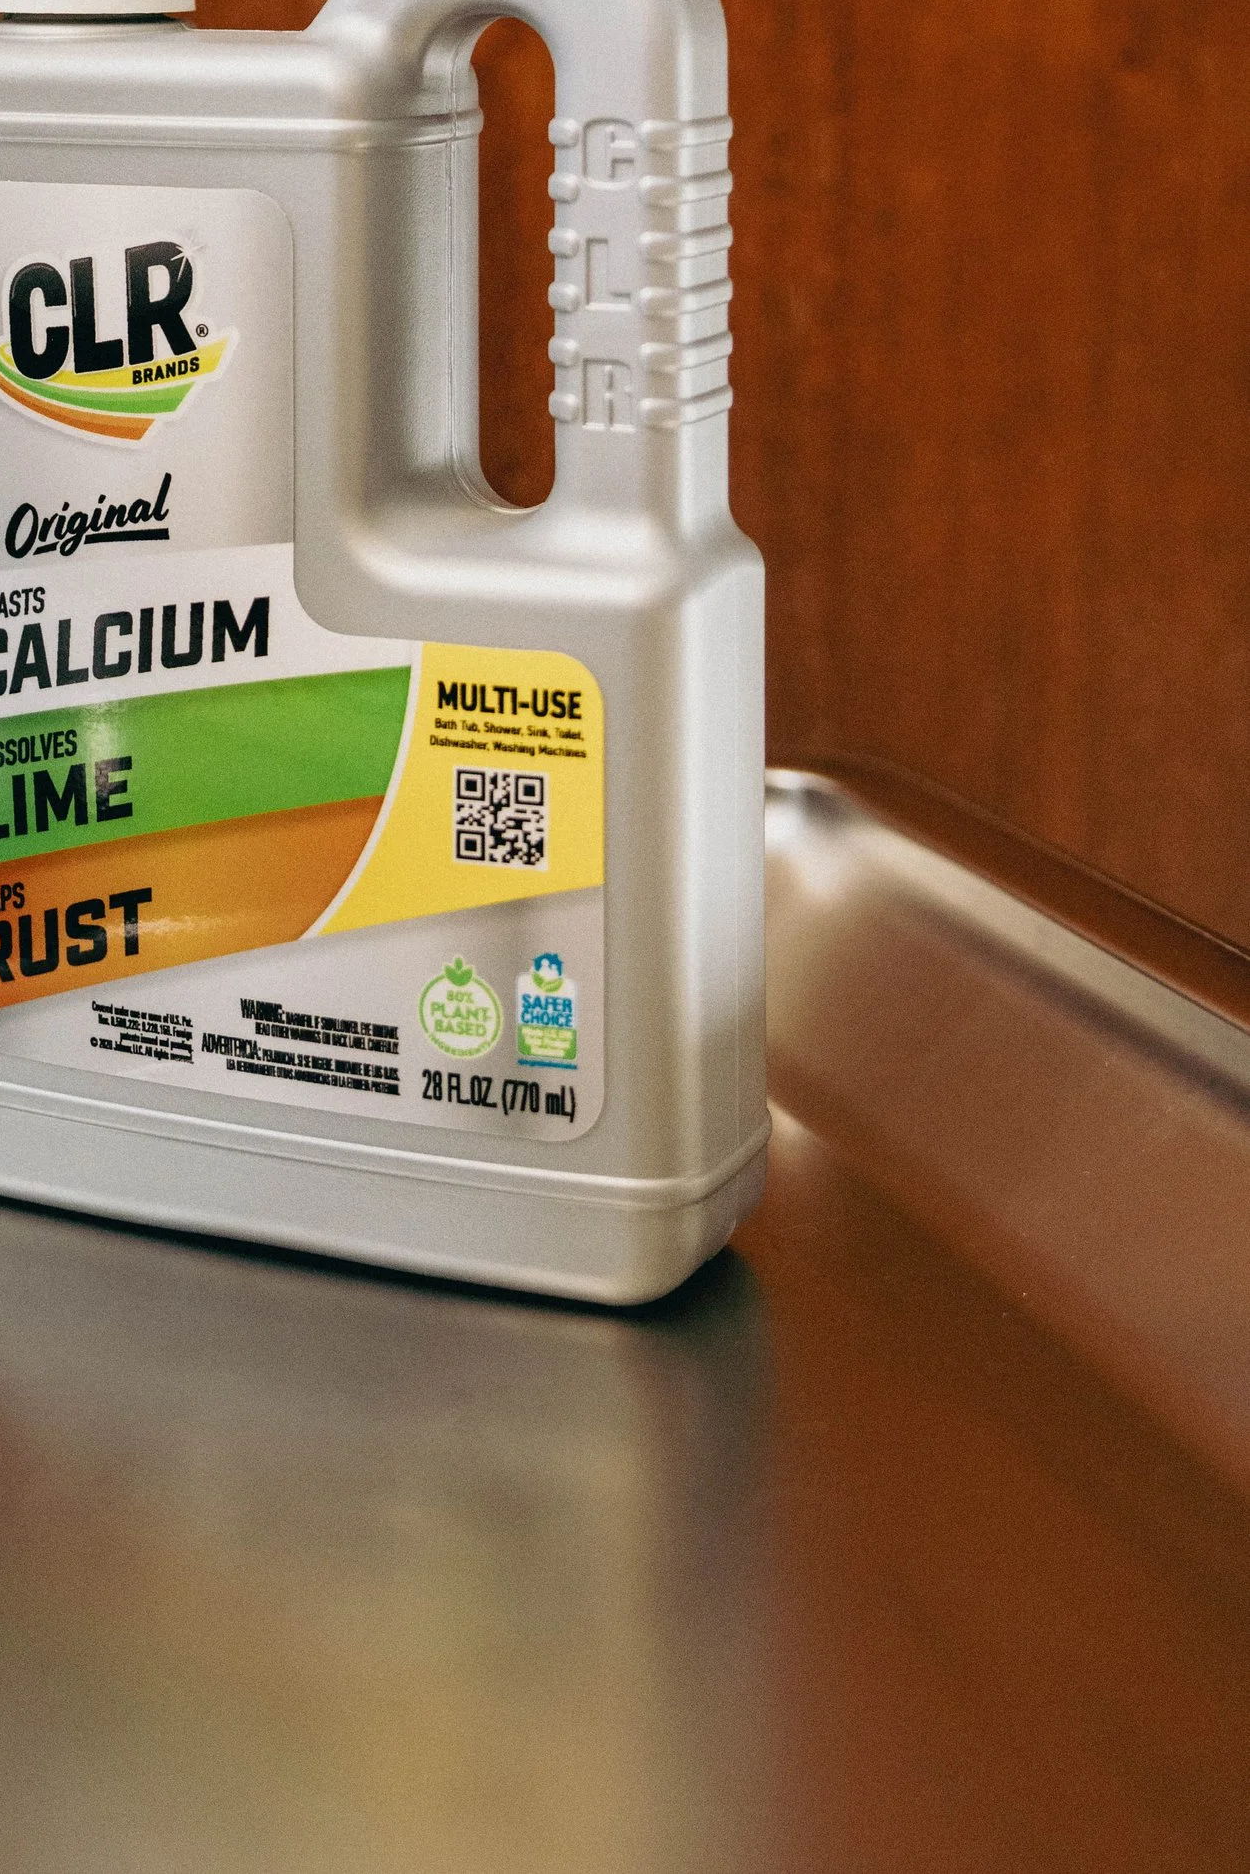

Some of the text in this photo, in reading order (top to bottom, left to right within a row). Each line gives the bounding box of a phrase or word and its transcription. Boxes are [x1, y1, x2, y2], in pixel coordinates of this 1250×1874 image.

[132, 356, 200, 385] BRANDS
[5, 472, 172, 559] Original
[437, 680, 582, 720] MULTI-USE
[434, 717, 457, 730] Bath
[483, 721, 523, 737] Shower,
[493, 740, 535, 757] Washing
[538, 744, 587, 759] Machines
[240, 997, 285, 1024] WARNING:
[430, 1000, 490, 1022] PLANT
[520, 1007, 573, 1028] CHOICE
[521, 993, 573, 1018] SAFER
[434, 1018, 487, 1037] BASED
[202, 1032, 262, 1061] ADVERTENCIA:
[421, 1068, 443, 1102] 28
[501, 1079, 540, 1116] (770
[545, 1085, 576, 1124] mL)
